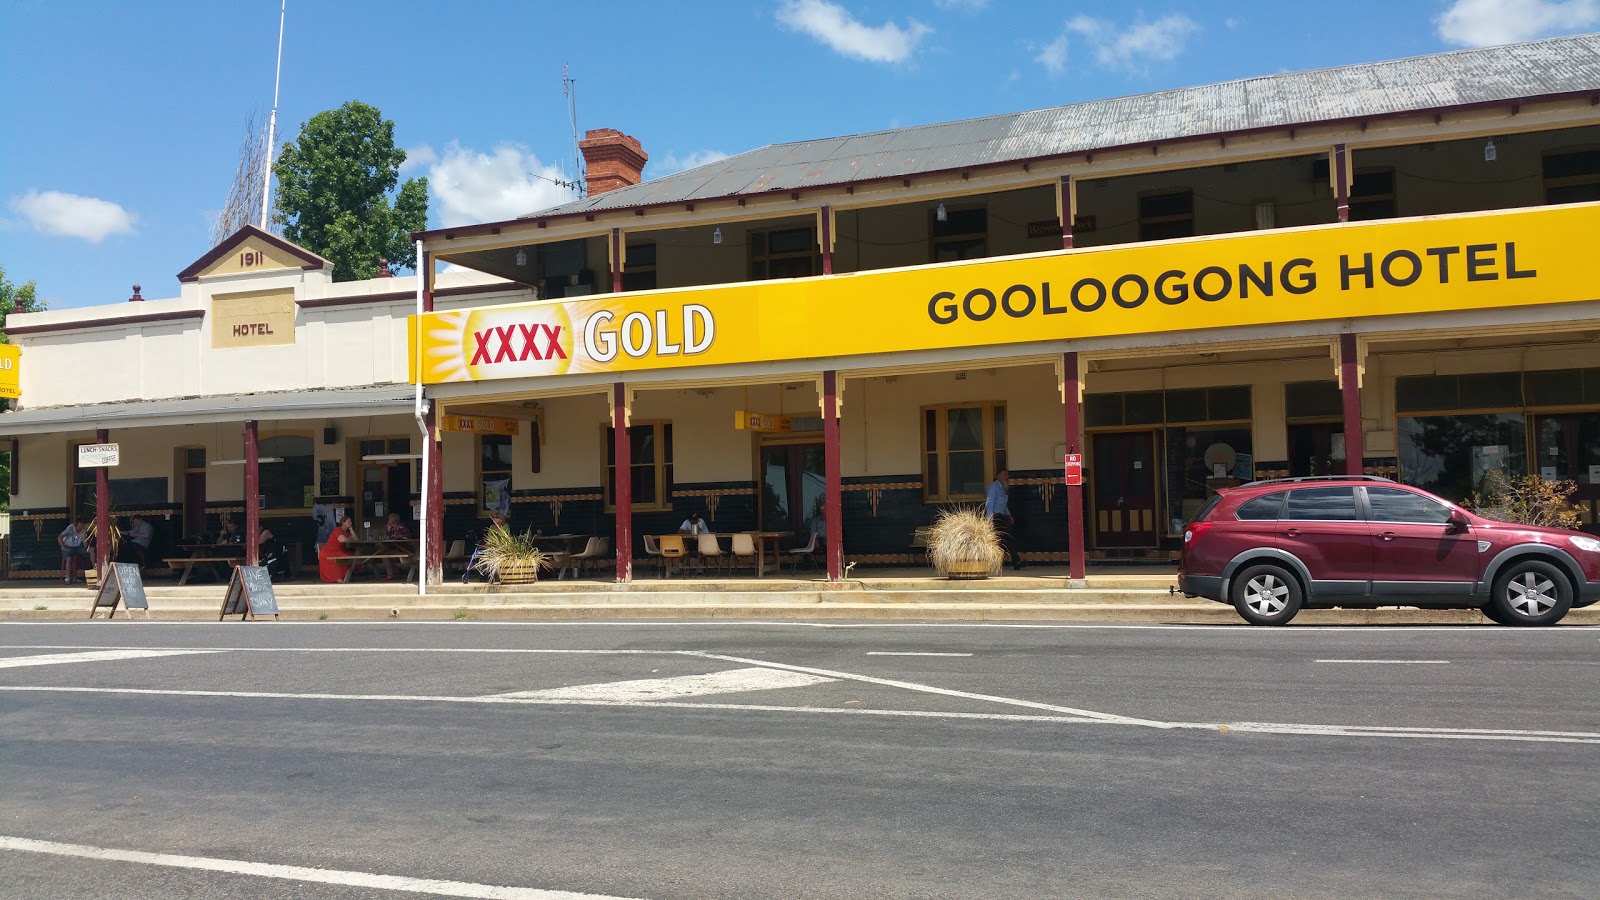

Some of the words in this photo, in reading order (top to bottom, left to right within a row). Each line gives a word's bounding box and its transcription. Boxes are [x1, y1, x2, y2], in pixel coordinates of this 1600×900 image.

[240, 251, 263, 268] 1911
[928, 258, 1317, 325] GOOLOOGONG
[1339, 241, 1537, 290] HOTEL
[232, 322, 274, 338] HOTEL
[470, 323, 568, 366] XXXX
[583, 303, 715, 363] GOLD
[0, 357, 12, 370] LD
[476, 418, 495, 431] GOLD
[117, 565, 140, 577] OPEN
[243, 569, 264, 581] LIVE
[244, 581, 270, 593] MUSIC
